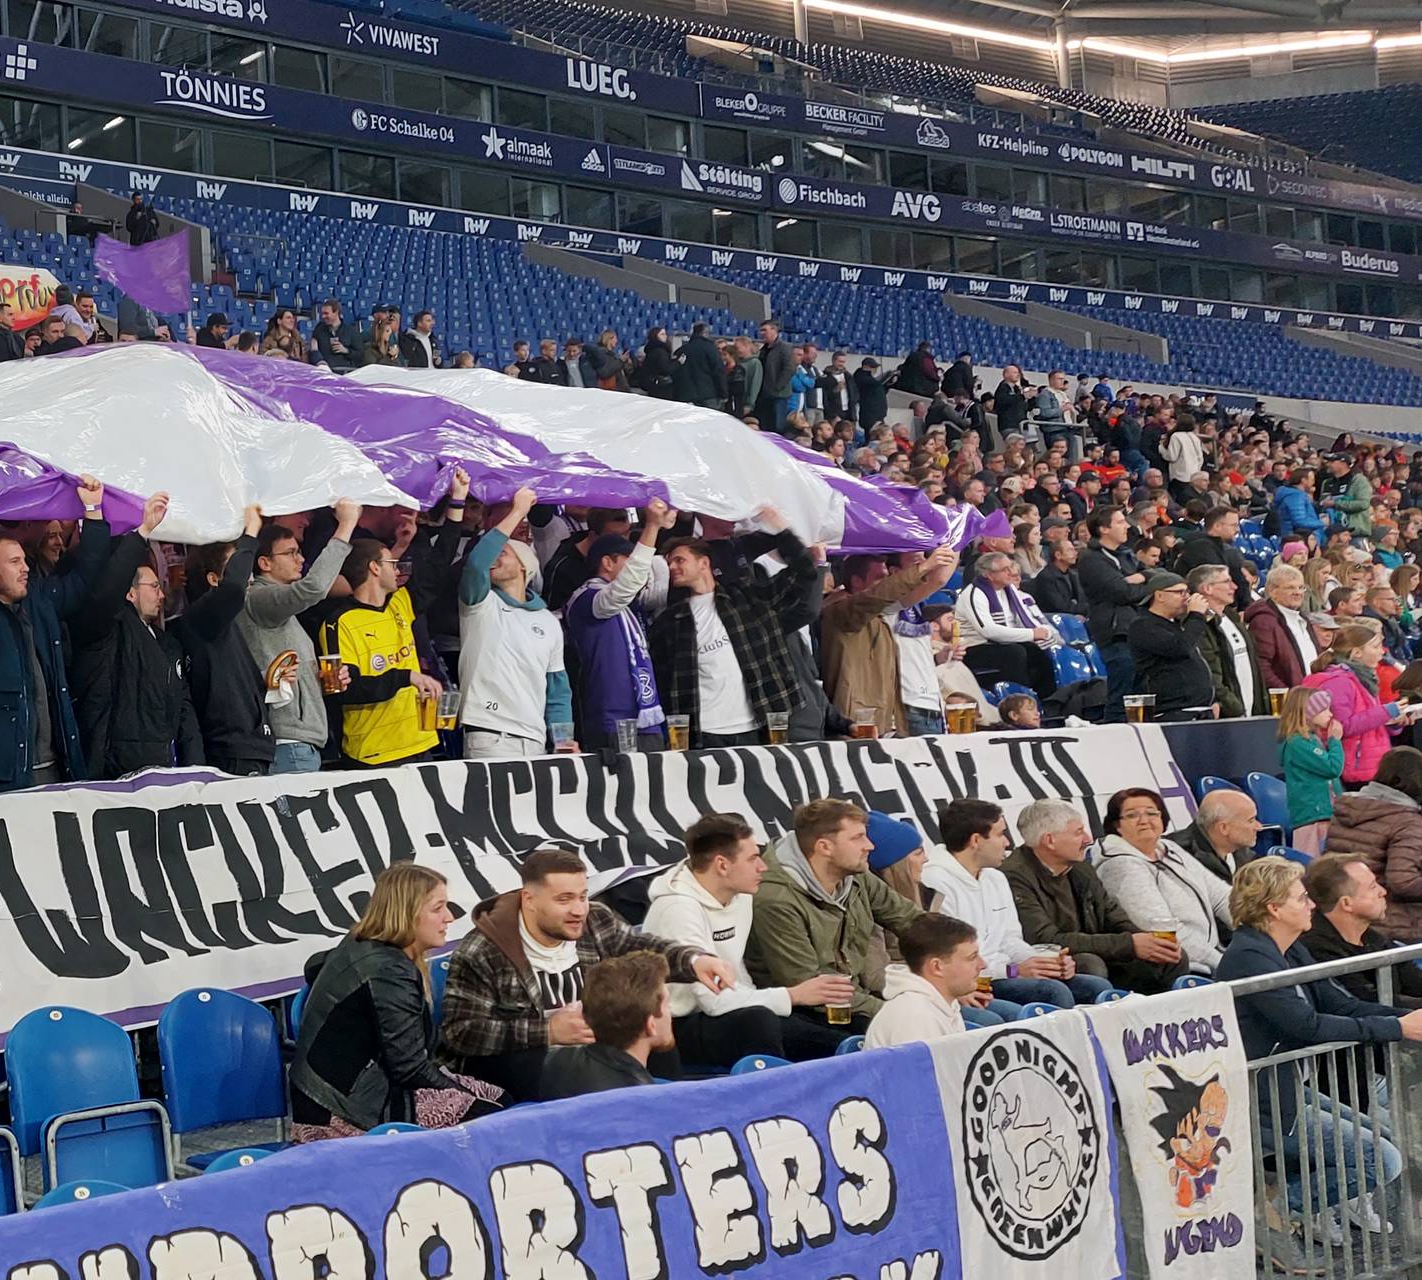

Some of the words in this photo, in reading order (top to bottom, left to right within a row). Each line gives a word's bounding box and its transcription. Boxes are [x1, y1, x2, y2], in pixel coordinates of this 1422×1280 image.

[368, 24, 439, 55] VIVAWEST
[160, 70, 266, 112] TÖNNIES
[566, 58, 637, 101] LUEG.
[370, 114, 387, 131] FC
[390, 117, 438, 140] Schalke
[439, 126, 454, 142] 04
[806, 104, 847, 122] BECKER
[847, 110, 884, 128] FACILITY
[506, 136, 553, 159] almaak
[977, 132, 1049, 157] KFZ-Helpline
[1071, 146, 1123, 168] POLYGON
[699, 163, 763, 192] Stölting
[1131, 155, 1195, 180] HILTI
[130, 171, 161, 191] R+V
[197, 181, 227, 200] R+V
[799, 184, 866, 208] Fischbach
[891, 191, 942, 222] AVG
[1341, 250, 1399, 273] Buderus
[485, 700, 498, 711] 20
[1014, 1039, 1087, 1115] NIGHT
